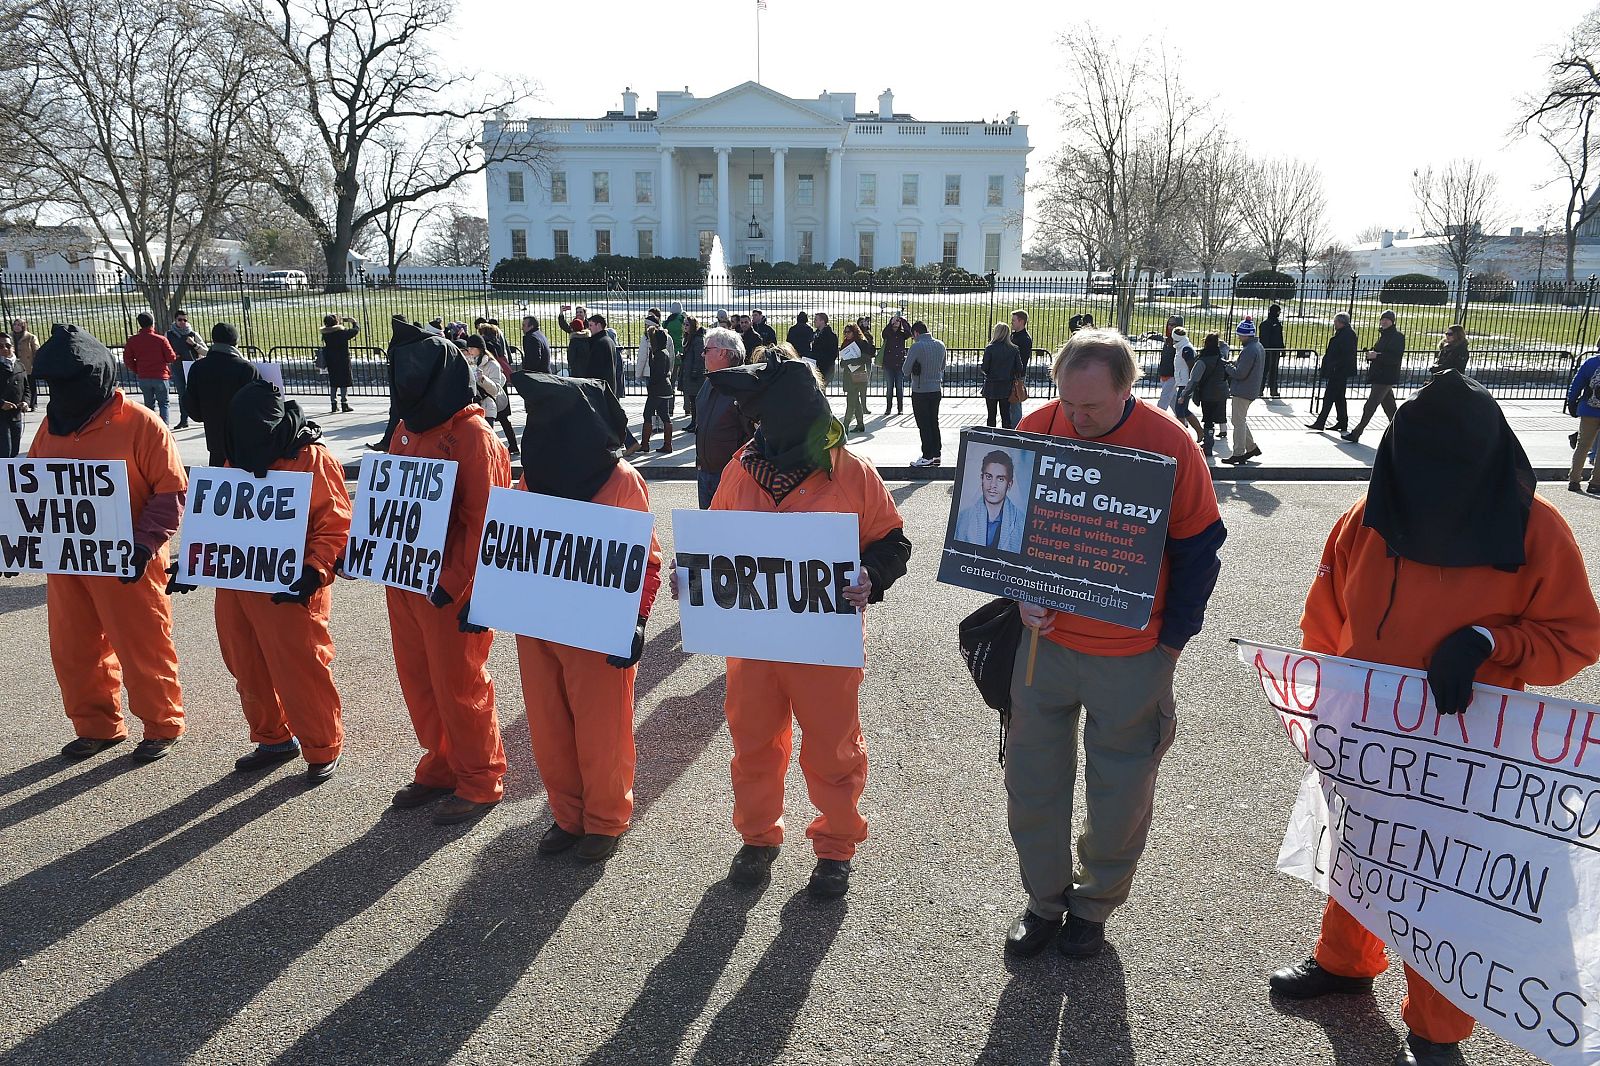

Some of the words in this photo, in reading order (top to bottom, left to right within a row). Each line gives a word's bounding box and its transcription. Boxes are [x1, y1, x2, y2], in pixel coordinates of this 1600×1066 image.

[8, 463, 38, 493] IS
[46, 463, 115, 496] THIS
[369, 459, 393, 492] IS
[399, 460, 444, 502] THIS
[1039, 455, 1102, 485] Free
[15, 498, 97, 535] WHO
[369, 497, 422, 543] WHO
[1033, 505, 1103, 527] Imprisoned
[1105, 518, 1120, 530] at
[1121, 523, 1147, 540] age
[1034, 483, 1086, 508] Fahd
[1092, 493, 1163, 524] Ghazy
[1028, 533, 1071, 552] charge
[1073, 541, 1109, 557] since
[1112, 549, 1148, 566] 2002.
[1031, 518, 1048, 531] 17.
[1051, 522, 1082, 538] Held
[1083, 530, 1135, 548] without
[0, 535, 43, 570] WE
[59, 537, 132, 575] ARE?
[187, 542, 296, 586] FEEDING
[348, 536, 376, 577] WE
[382, 542, 441, 593] ARE?
[481, 519, 646, 594] GUANTANAMO
[1027, 547, 1075, 566] Cleared
[1077, 556, 1090, 569] in
[1093, 560, 1129, 576] 2007.
[676, 552, 857, 615] TORTURE
[1002, 586, 1077, 614] CCRjustice.org
[1254, 651, 1321, 712] NO
[1313, 723, 1487, 806] SECRET
[1387, 909, 1588, 1048] PROCESS
